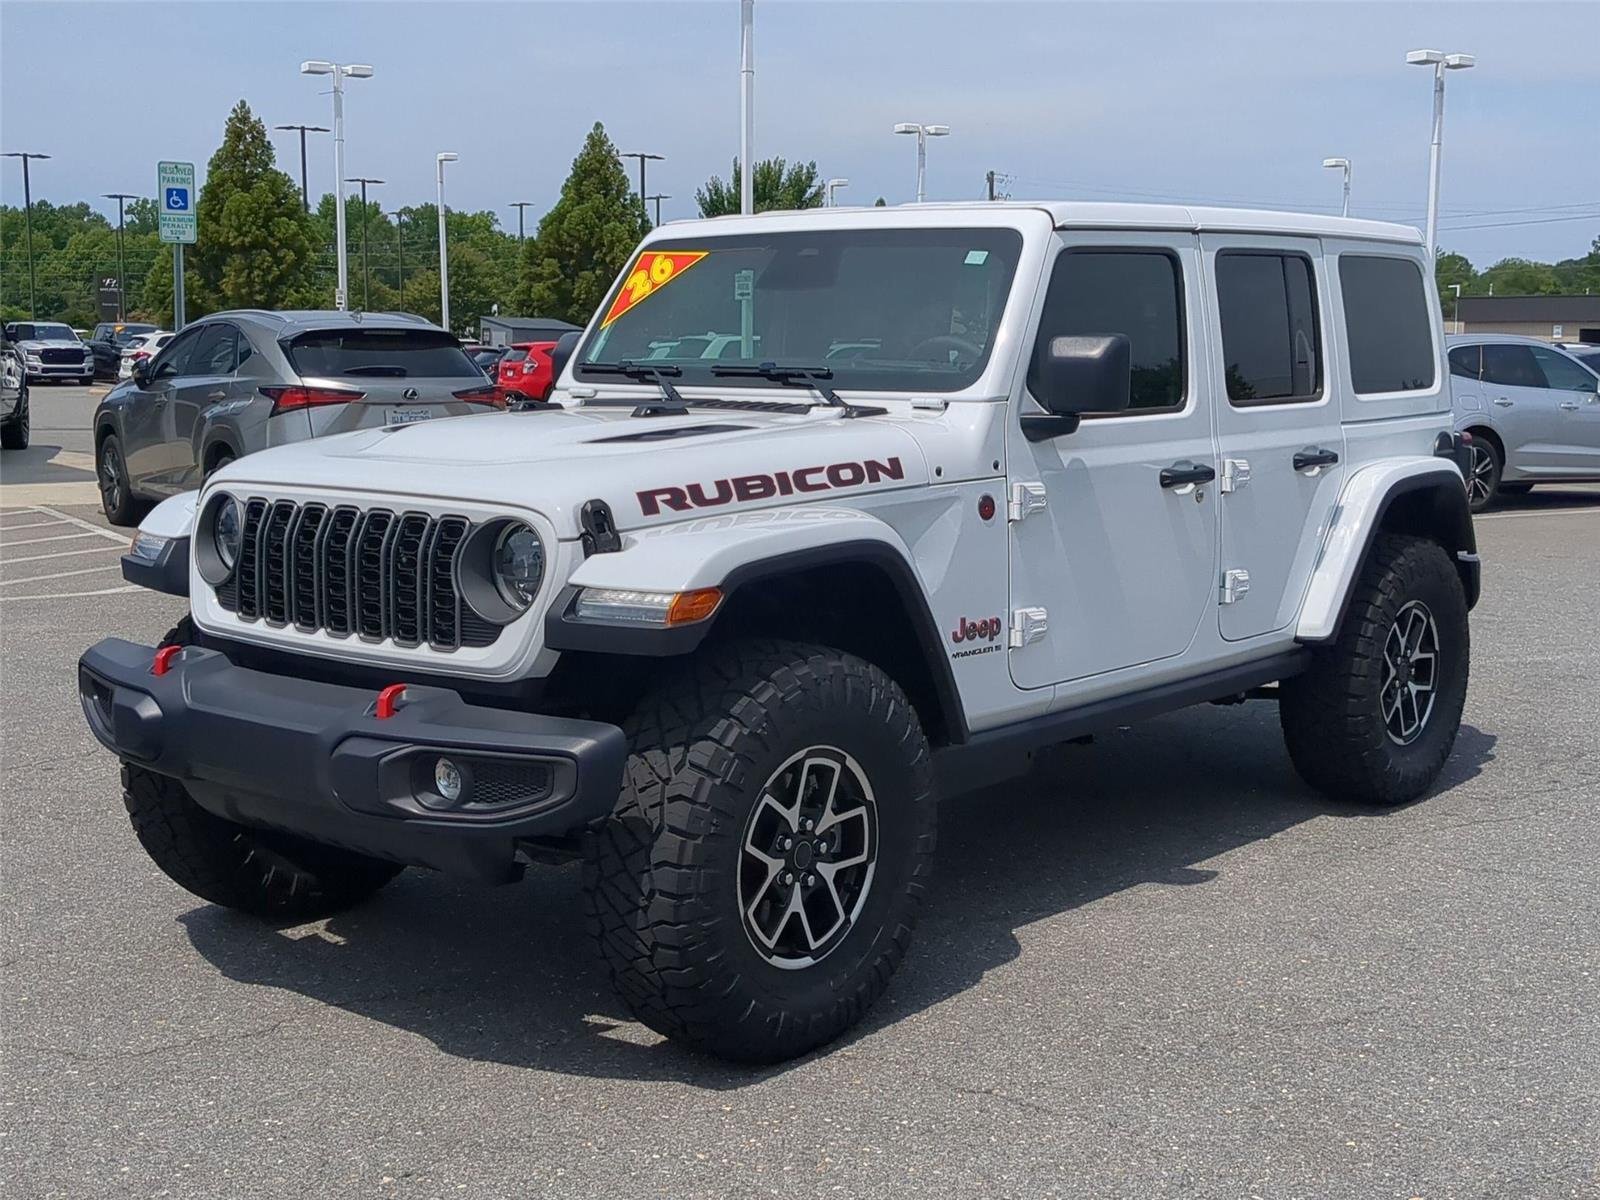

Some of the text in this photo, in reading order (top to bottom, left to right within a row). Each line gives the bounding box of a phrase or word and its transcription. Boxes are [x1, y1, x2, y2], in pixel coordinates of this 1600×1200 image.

[160, 166, 192, 176] RESERVED
[162, 176, 191, 184] PARKING
[626, 255, 674, 302] 26
[635, 456, 905, 517] RUBICON
[952, 616, 1002, 643] Jeep
[951, 646, 994, 660] WRANGLER
